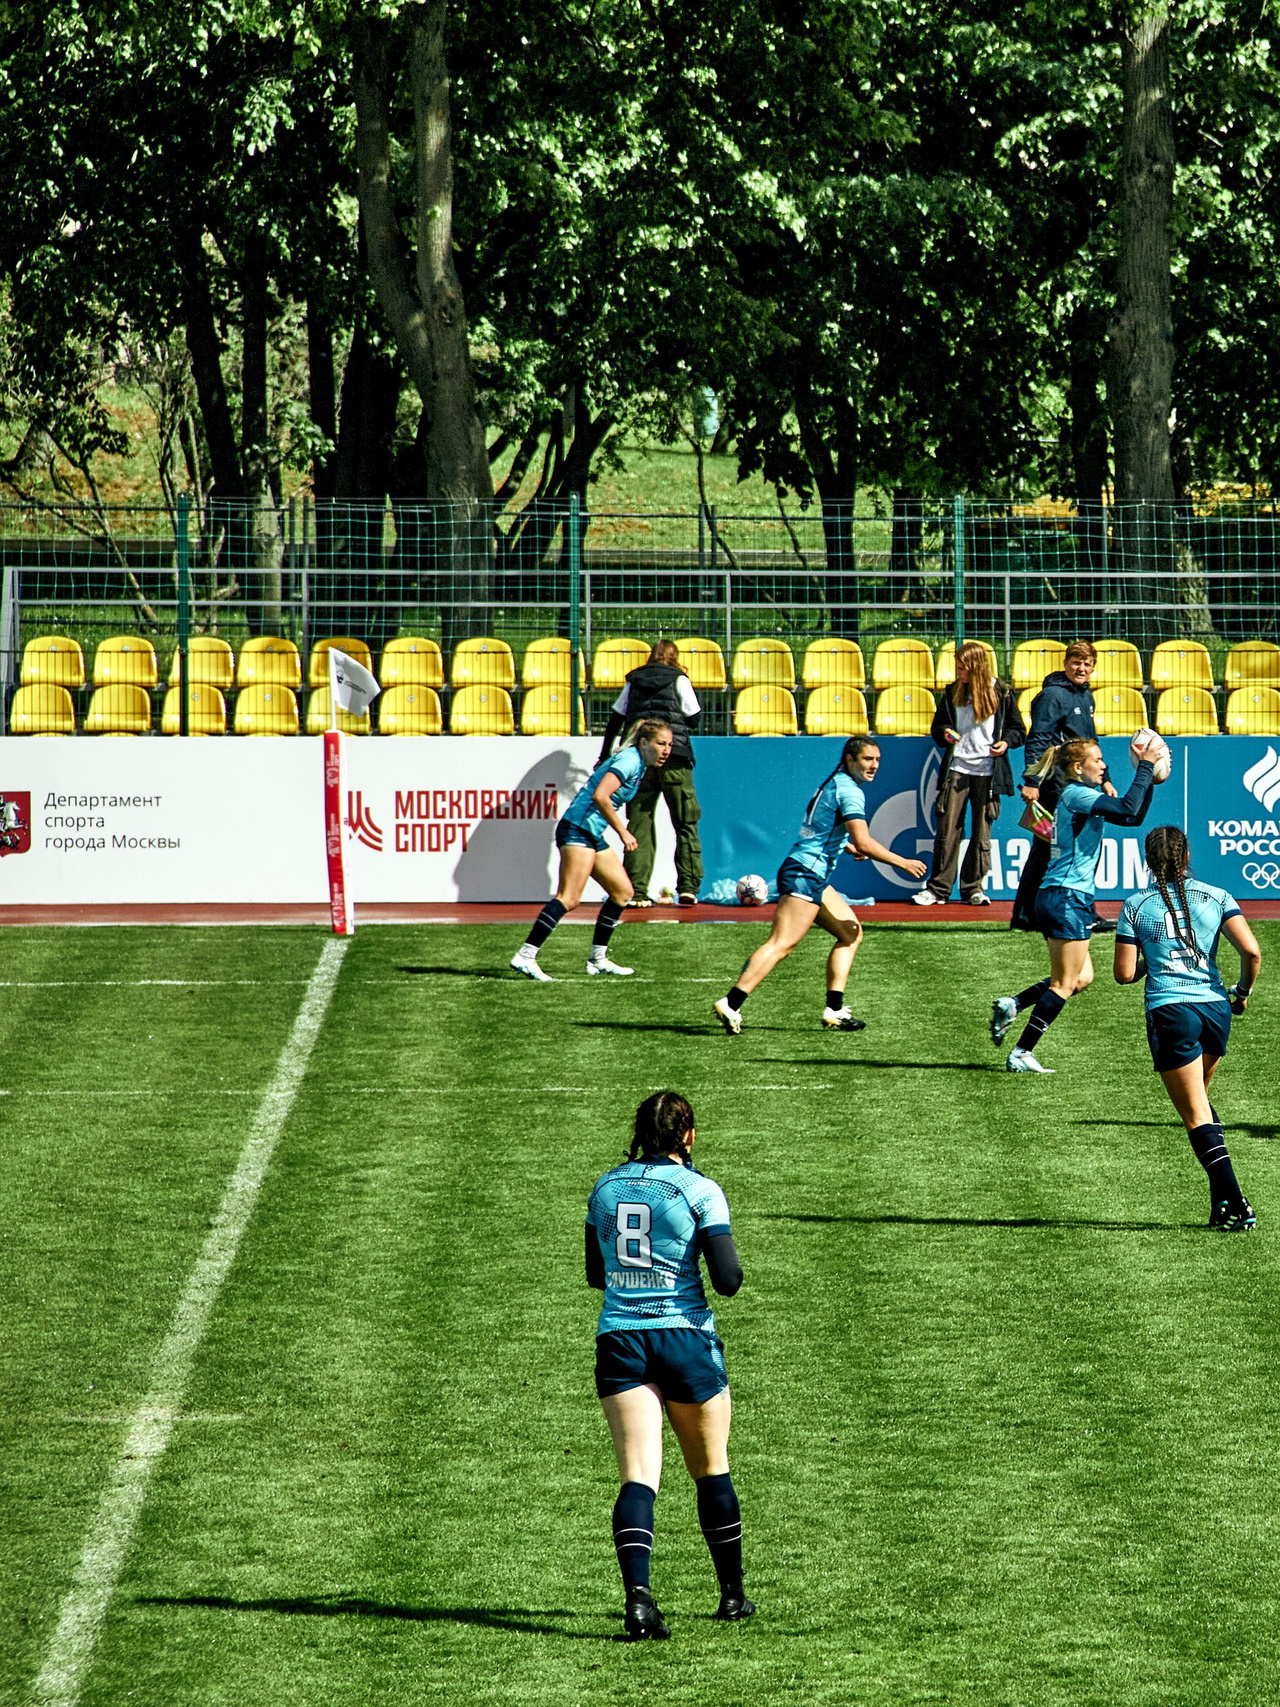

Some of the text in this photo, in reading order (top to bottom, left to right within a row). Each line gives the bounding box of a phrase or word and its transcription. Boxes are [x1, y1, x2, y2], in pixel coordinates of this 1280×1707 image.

[44, 792, 162, 811] Департамент
[395, 783, 558, 819] МОСКОВСКИЙ
[44, 816, 105, 832] спорта
[45, 834, 181, 852] города Москвы
[395, 823, 471, 852] СПОРТ
[616, 1202, 652, 1268] 8
